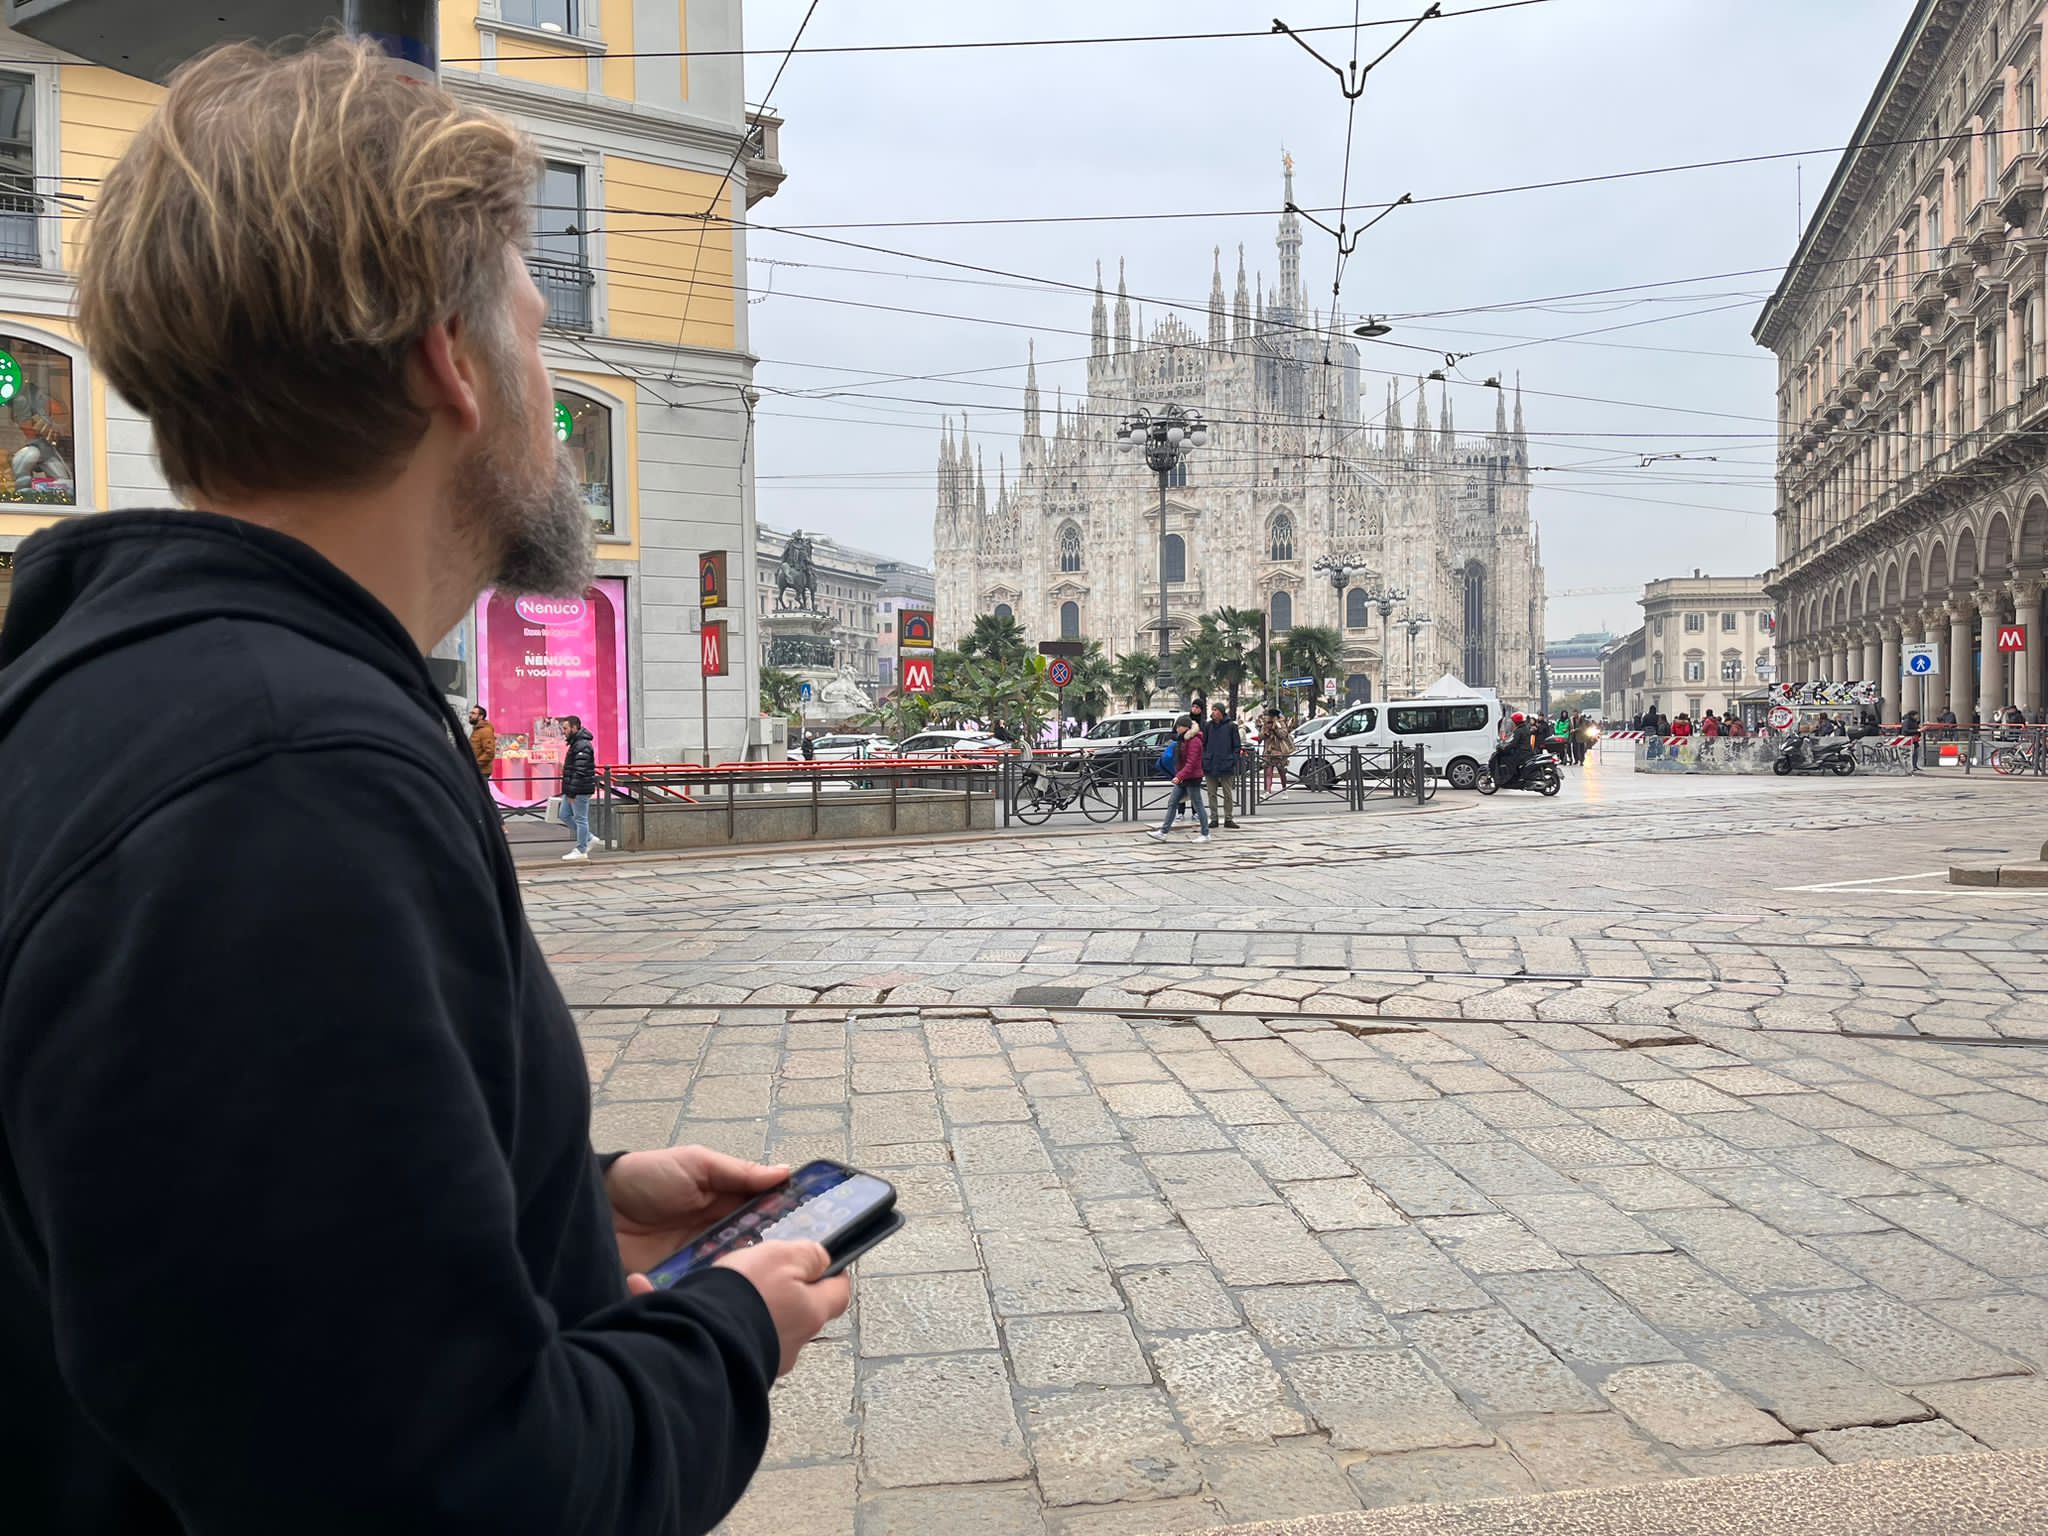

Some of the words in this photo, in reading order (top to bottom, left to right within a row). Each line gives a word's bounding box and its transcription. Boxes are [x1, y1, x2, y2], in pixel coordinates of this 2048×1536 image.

[520, 601, 580, 615] Nenuco
[1998, 631, 2023, 648] M
[703, 635, 720, 666] M
[524, 654, 582, 667] NENUCO
[905, 665, 931, 686] M
